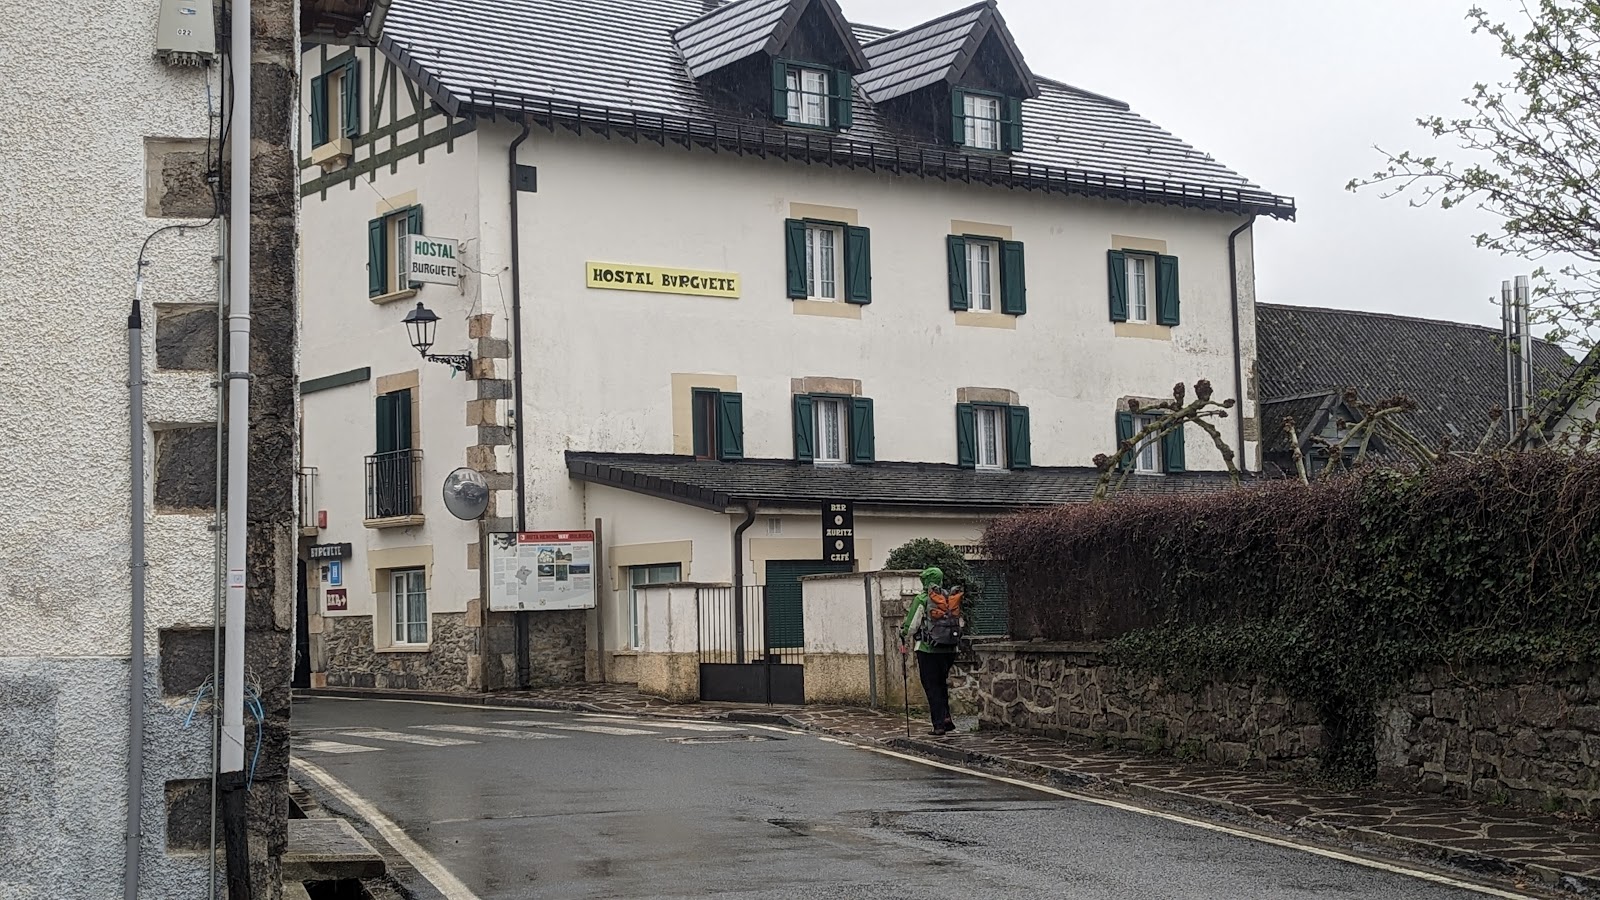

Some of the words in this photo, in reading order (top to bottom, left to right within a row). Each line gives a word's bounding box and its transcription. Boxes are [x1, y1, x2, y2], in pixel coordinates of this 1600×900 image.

[414, 240, 456, 259] HOSTAL
[411, 261, 457, 278] BURGUETE
[592, 267, 654, 286] HOSTAL
[830, 504, 847, 512] BAR
[825, 528, 853, 537] AURITZ
[830, 551, 850, 562] CAFÉ
